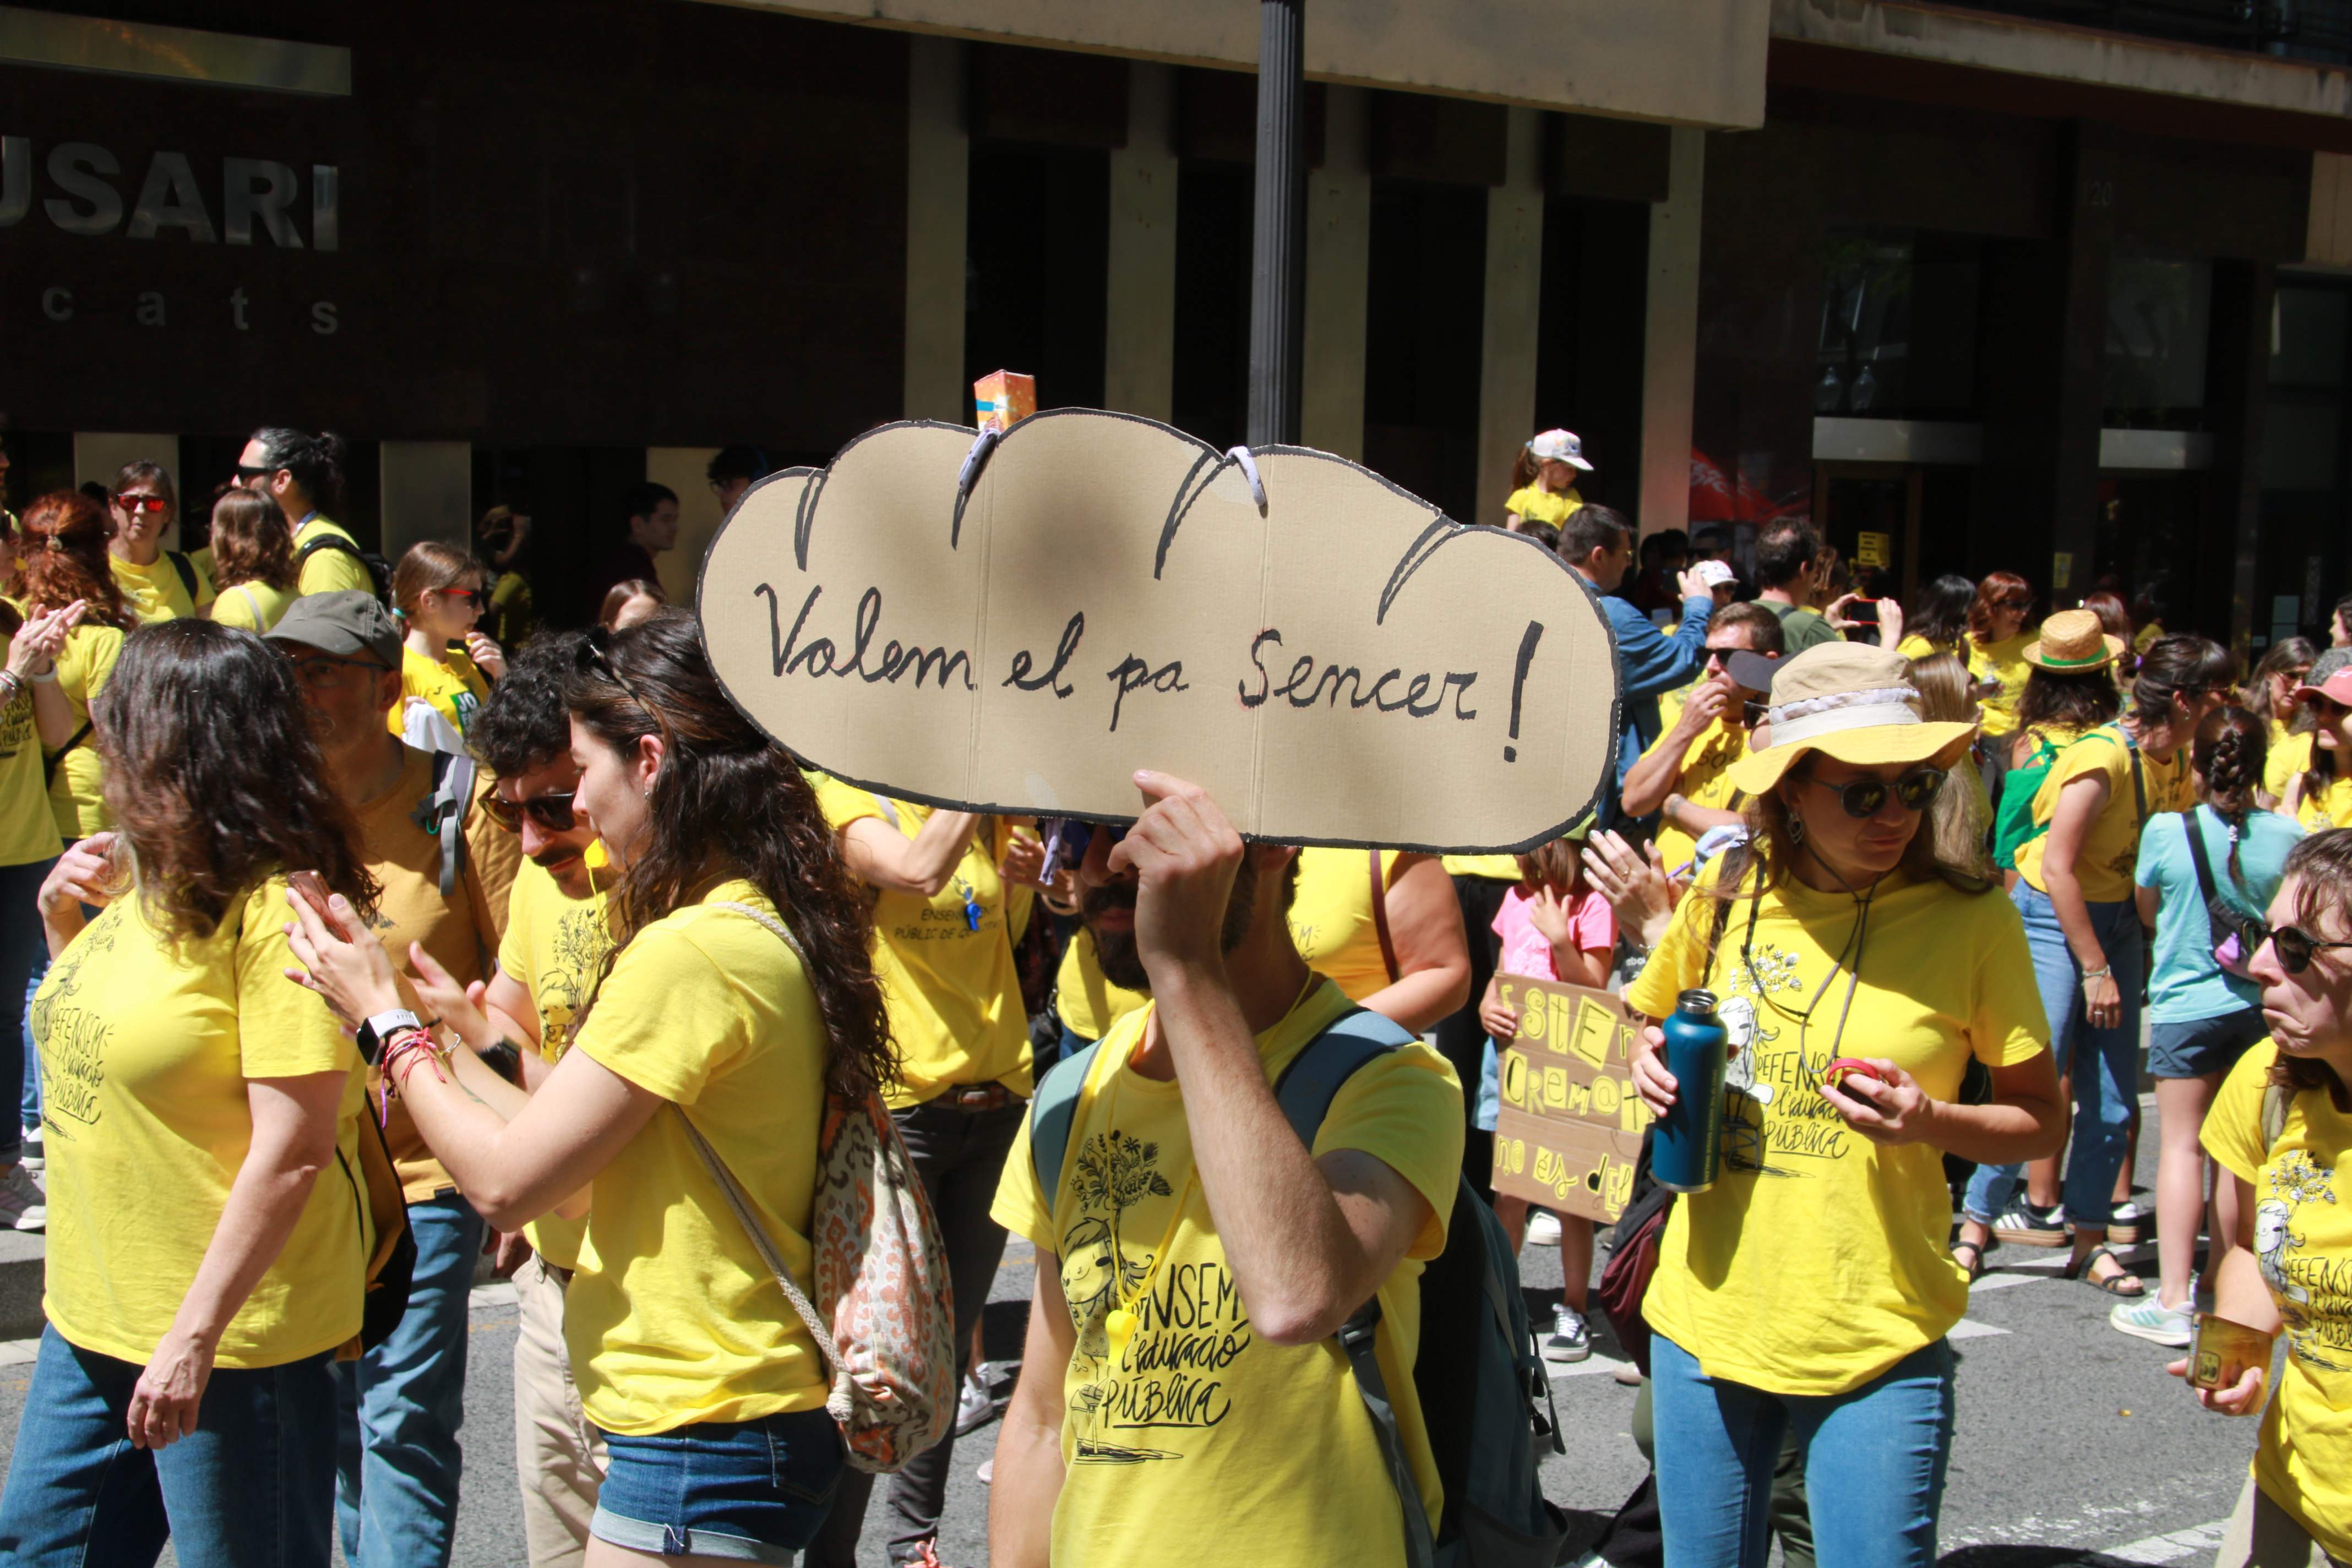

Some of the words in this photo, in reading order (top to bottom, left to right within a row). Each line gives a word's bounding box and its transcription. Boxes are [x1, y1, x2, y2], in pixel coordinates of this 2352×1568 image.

[1001, 611, 1084, 699] el
[1107, 652, 1189, 732] pa
[2285, 1257, 2352, 1297] DEFENS
